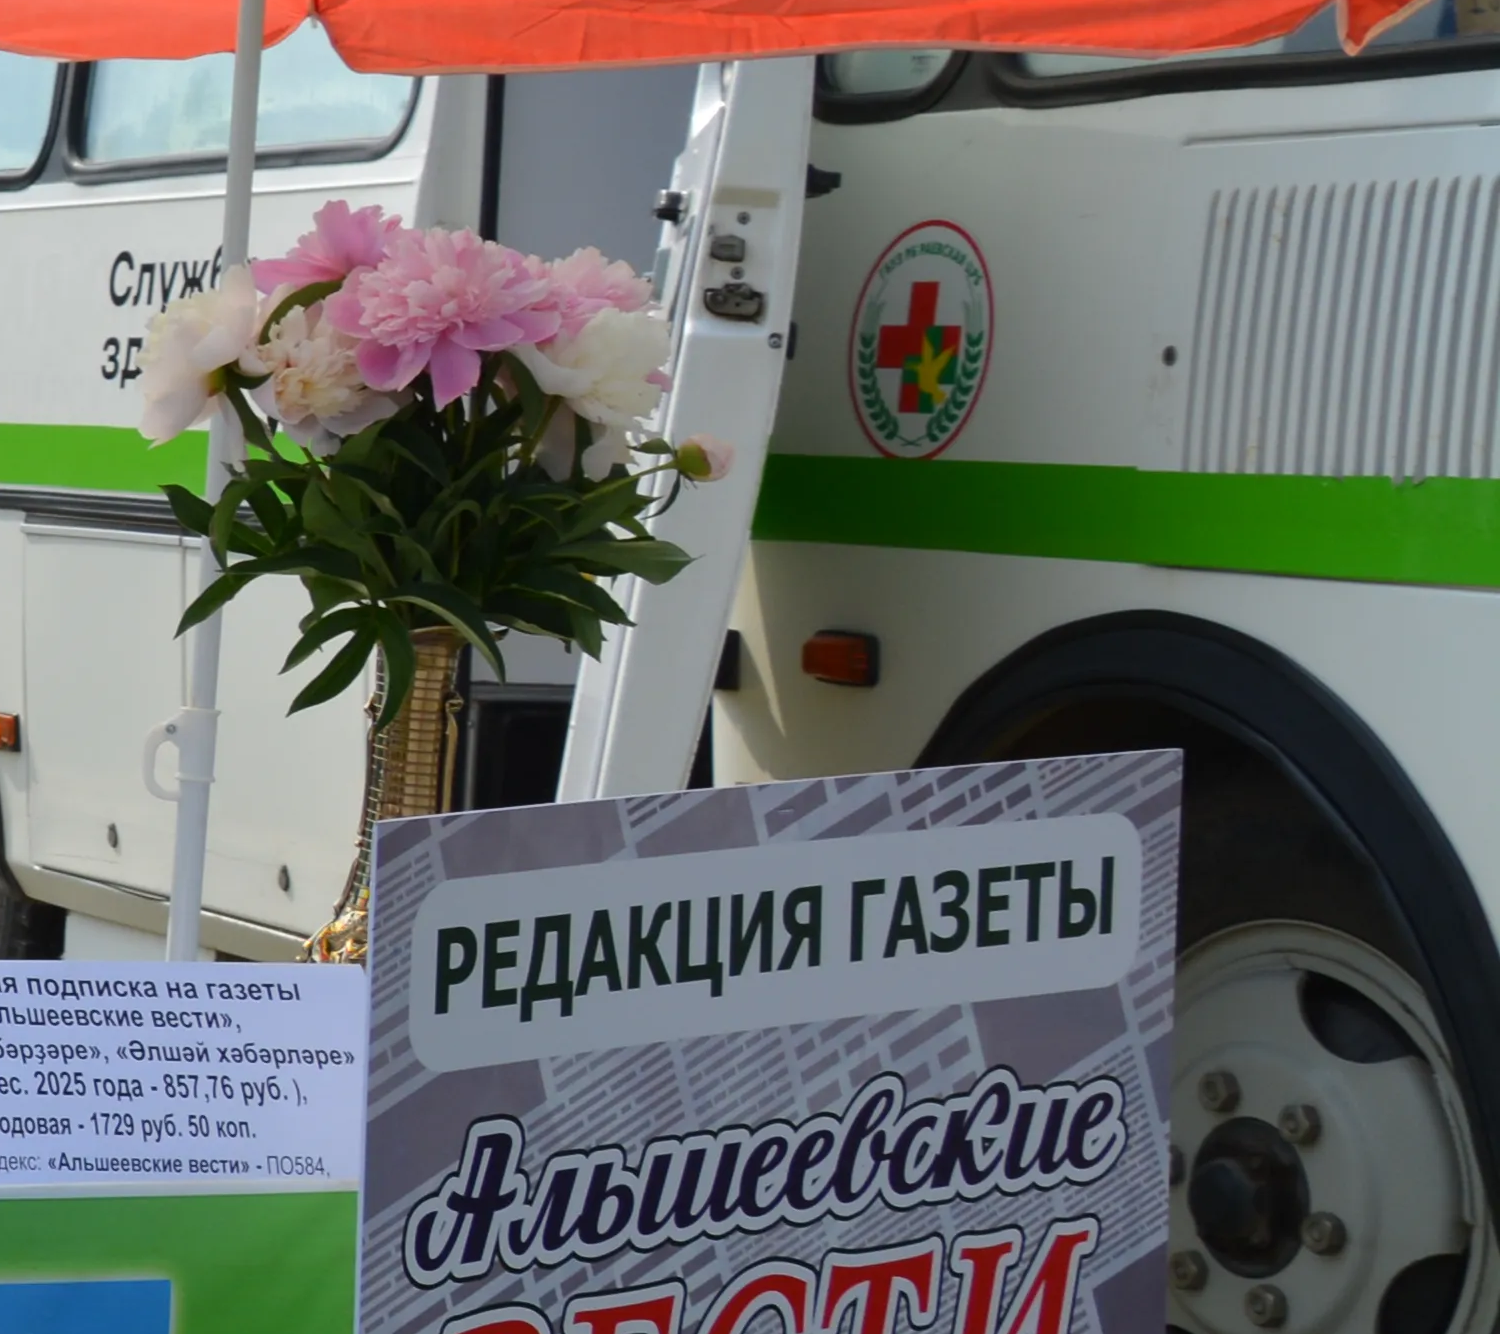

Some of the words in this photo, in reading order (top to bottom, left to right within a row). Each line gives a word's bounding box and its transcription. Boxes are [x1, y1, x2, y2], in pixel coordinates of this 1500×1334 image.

[109, 244, 242, 314] Служ
[433, 882, 824, 1023] РЕДАКЦИЯ
[849, 856, 1116, 962] ГАЗЕТЫ
[27, 977, 158, 1000] подписка
[166, 981, 199, 1000] на
[206, 982, 301, 1001] газеты
[152, 1010, 241, 1033] вести»,
[116, 1040, 210, 1063] «Әлшәй
[218, 1043, 355, 1069] хәбәрләре»
[33, 1071, 86, 1096] 2025
[93, 1078, 144, 1102] года
[163, 1074, 234, 1102] 857,76
[240, 1076, 288, 1107] руб.
[90, 1112, 135, 1136] 1729
[141, 1113, 182, 1143] руб.
[188, 1114, 210, 1137] 50
[217, 1120, 257, 1138] коп.
[48, 1152, 182, 1173] «Альшеевские
[189, 1157, 250, 1174] вести»
[266, 1155, 330, 1177] ПО584,
[407, 1067, 1126, 1285] Альшеевские
